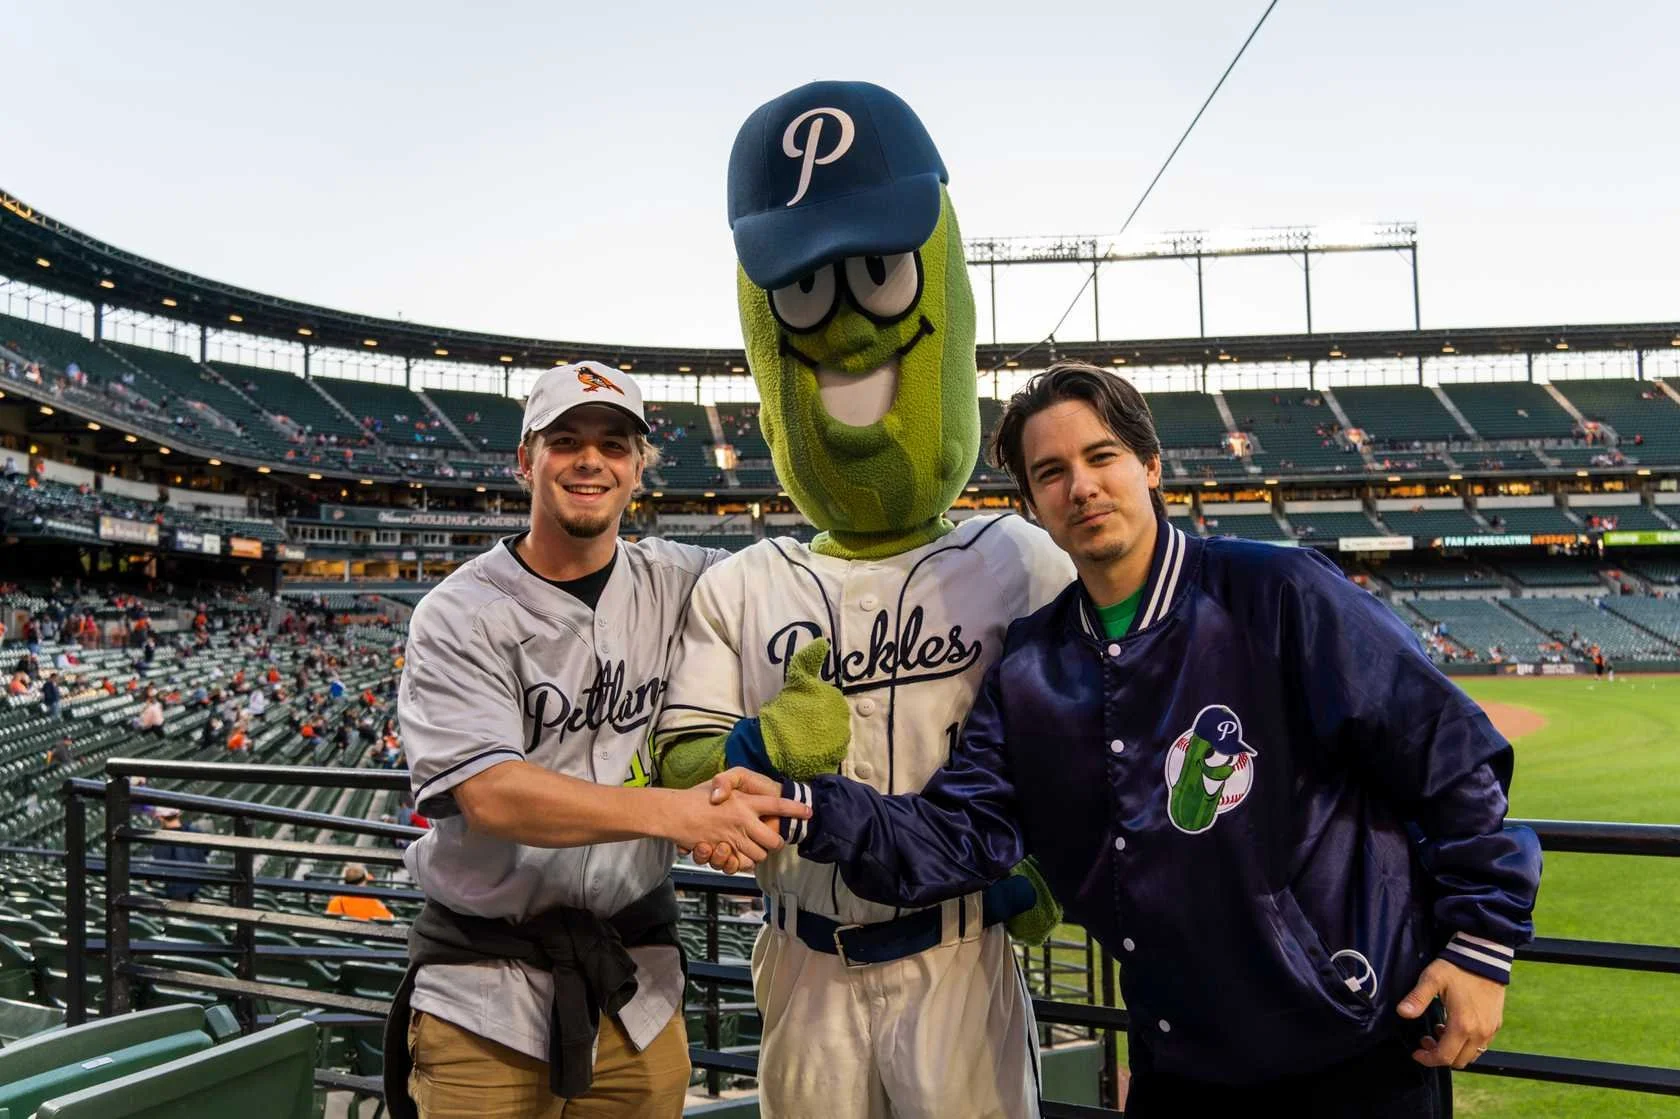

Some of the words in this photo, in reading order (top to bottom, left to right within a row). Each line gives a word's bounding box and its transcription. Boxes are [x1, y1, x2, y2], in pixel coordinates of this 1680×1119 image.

[783, 107, 855, 206] P
[1445, 536, 1464, 546] FAN
[1466, 535, 1531, 546] APPRECIATION
[1217, 721, 1237, 741] P
